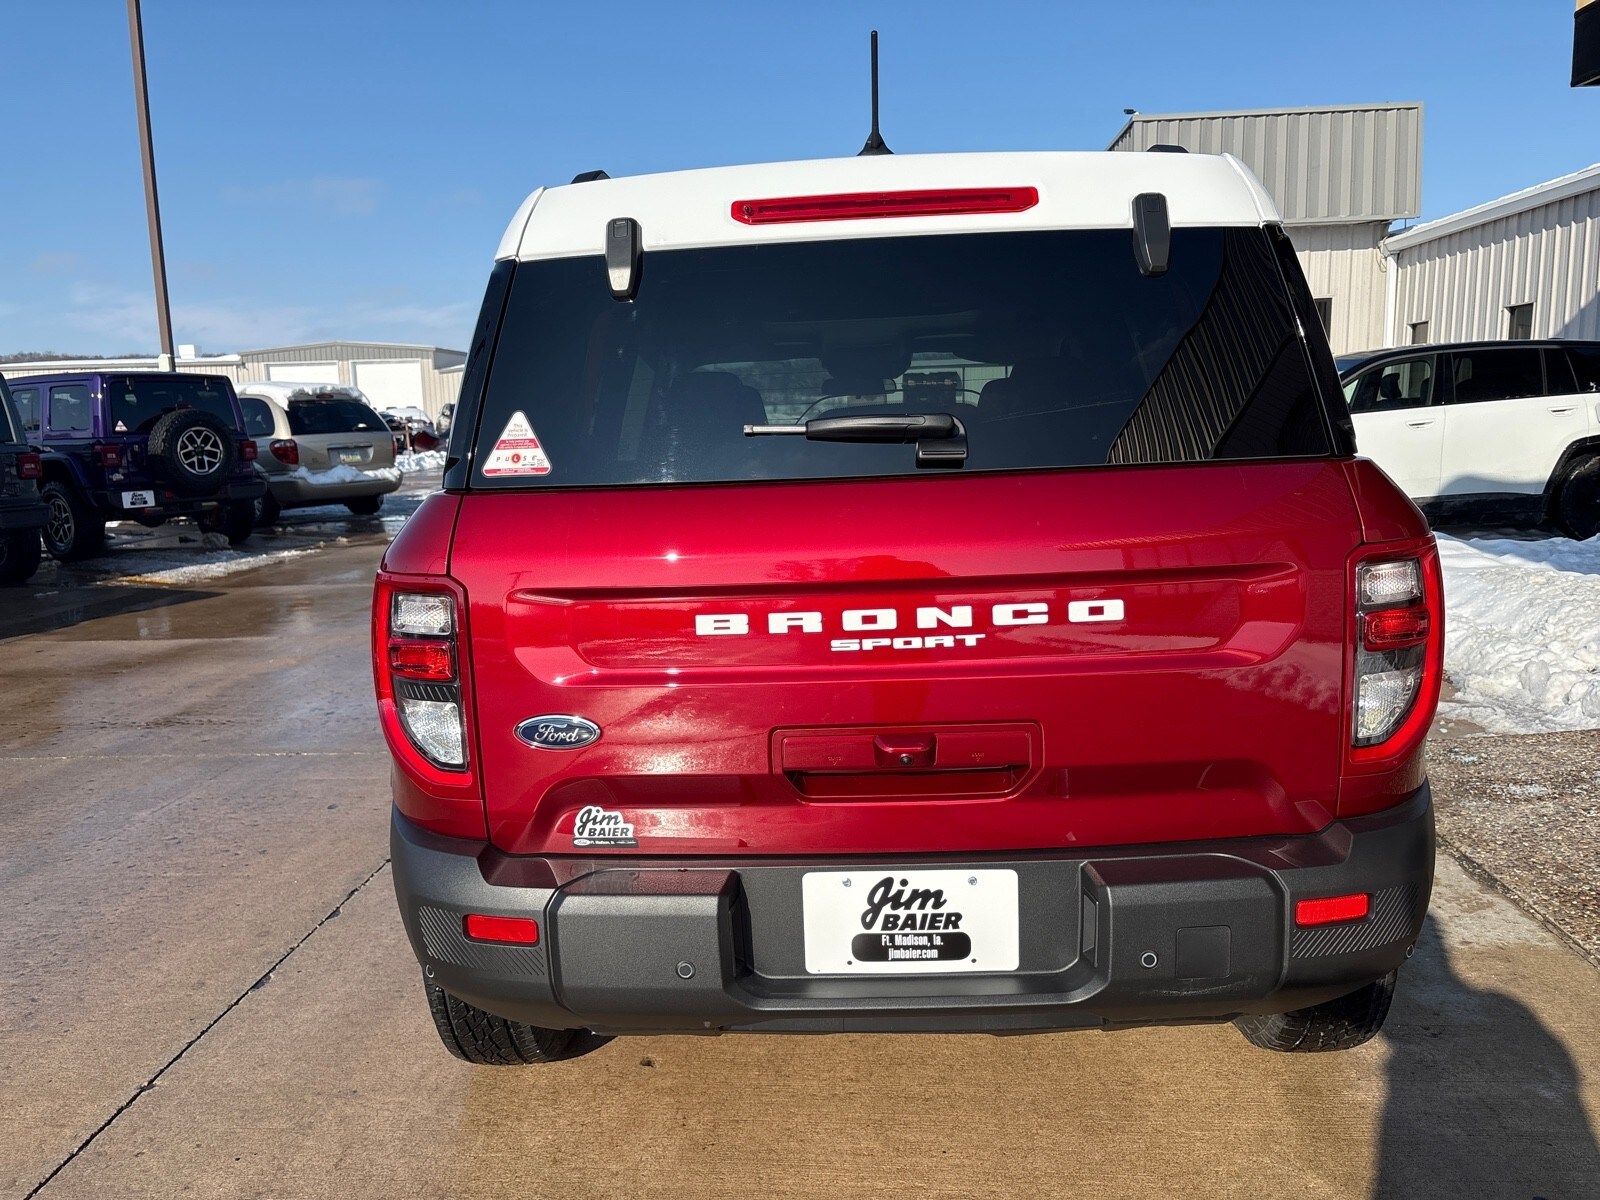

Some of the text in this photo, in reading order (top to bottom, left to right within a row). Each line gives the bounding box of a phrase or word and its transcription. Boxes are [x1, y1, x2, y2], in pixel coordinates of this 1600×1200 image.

[694, 598, 1125, 636] BRONCO
[830, 634, 986, 652] SPORT
[534, 722, 579, 742] Ford
[577, 808, 621, 836] Jim
[588, 827, 630, 837] BAIER
[861, 876, 947, 930] Jim
[880, 912, 962, 931] BAIER
[881, 935, 892, 946] Ft.
[895, 934, 931, 947] Madison,
[888, 947, 938, 960] jimbaier.com
